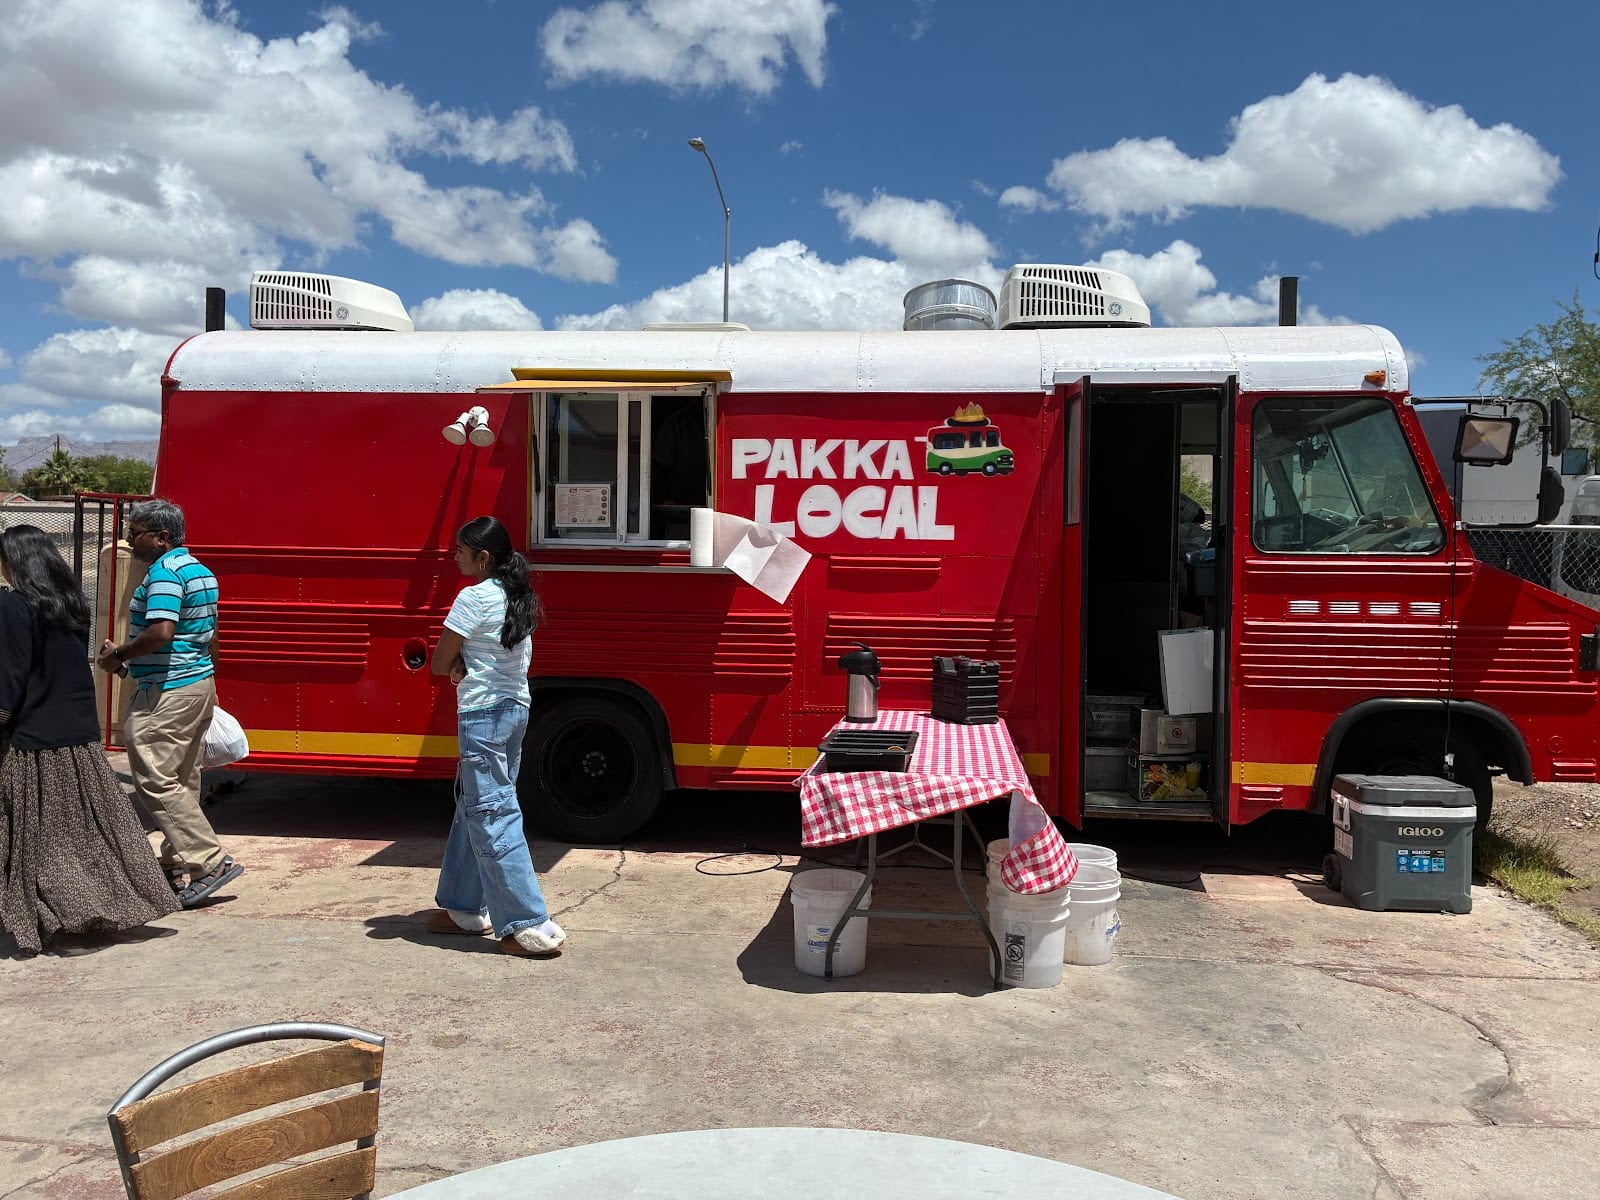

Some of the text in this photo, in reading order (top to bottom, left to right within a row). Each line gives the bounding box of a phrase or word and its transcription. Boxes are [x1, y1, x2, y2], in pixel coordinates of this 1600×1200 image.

[731, 438, 914, 480] PAKKA
[754, 484, 955, 541] LOCAL
[1398, 826, 1445, 837] IGLOO
